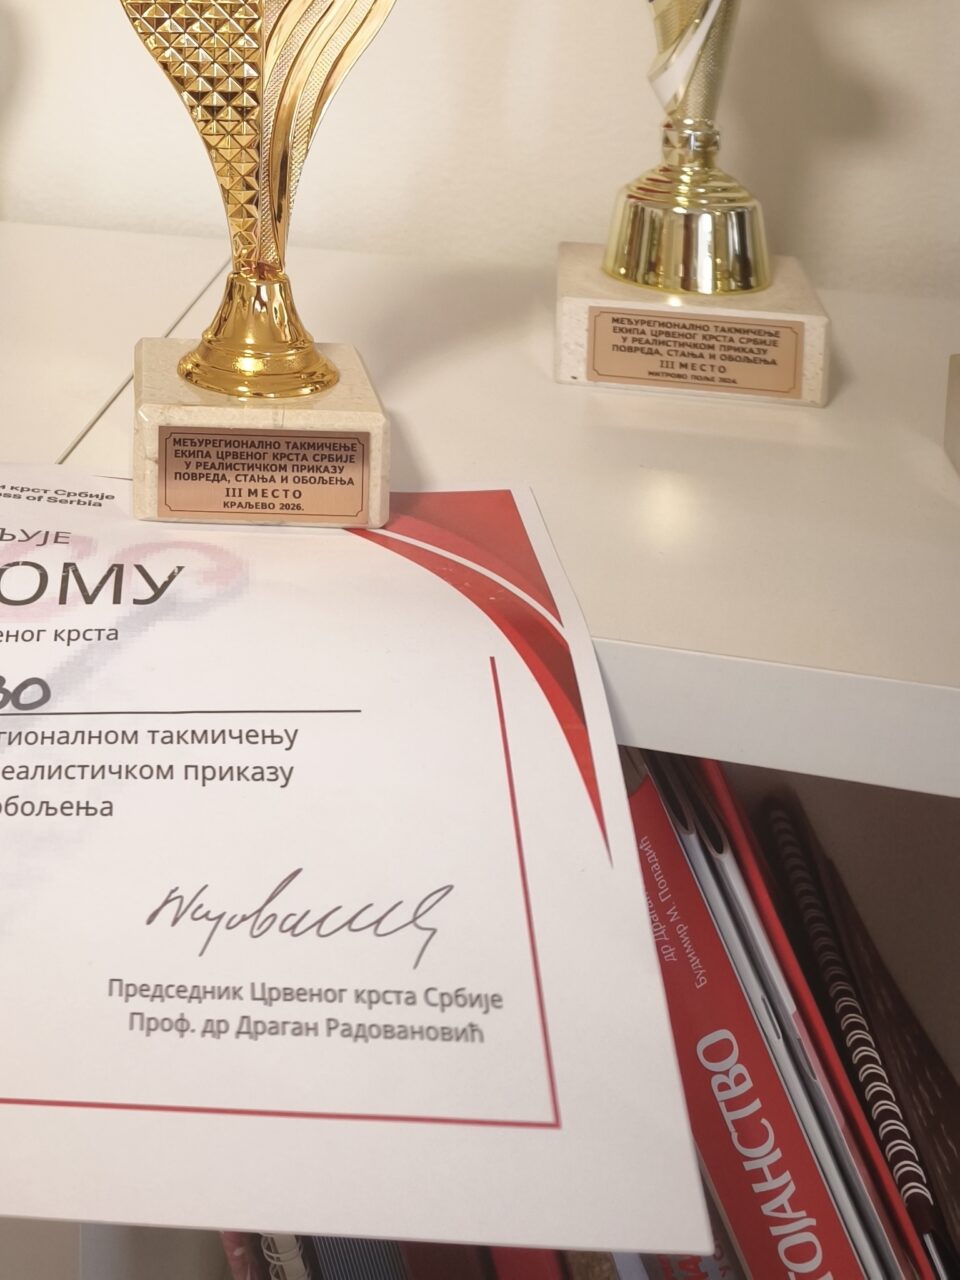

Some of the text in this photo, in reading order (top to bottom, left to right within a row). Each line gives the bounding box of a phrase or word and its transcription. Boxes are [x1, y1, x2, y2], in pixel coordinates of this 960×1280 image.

[612, 316, 781, 338] МЕЂУРЕГИОНАЛНО ТАКМИЧЕЊЕ
[612, 326, 779, 348] ЕКИПА ЦРВЕНОГ КРСТА СРБИЈЕ
[621, 335, 768, 356] У РЕАЛИСТИЧКОМ ПРИКАЗУ
[667, 349, 705, 360] СТАЊА
[709, 353, 716, 361] И
[720, 353, 777, 366] ОБОЉЕЊА
[679, 361, 727, 374] МЕСТО
[173, 438, 357, 452] МЕЂУРЕГИОНАЛНО ТАКМИЧЕЊЕ
[174, 449, 355, 464] ЕКИПА ЦРВЕНОГ КРСТА СРБИЈЕ
[184, 461, 344, 475] У РЕАЛИСТИЧКОМ ПРИКАЗУ
[174, 472, 354, 486] ПОВРЕДА, СТАЊА И ОБОЉЕЊА
[10, 484, 51, 496] крст
[53, 489, 116, 501] Србије
[26, 494, 43, 502] of
[46, 496, 102, 508] Serbia
[247, 488, 302, 499] МЕСТО
[223, 501, 304, 511] КРАЉЕВО 2026.
[53, 627, 120, 646] крста
[147, 728, 299, 751] такмичењу
[184, 764, 294, 788] приказу
[640, 836, 707, 989] Будимир М. Попадић
[661, 944, 677, 962] др
[108, 978, 503, 1014] Председник Црвеног крста Србије
[128, 1012, 484, 1043] Проф. др Драган Радовановић
[696, 1029, 833, 1280] ОЈАНСТВО
